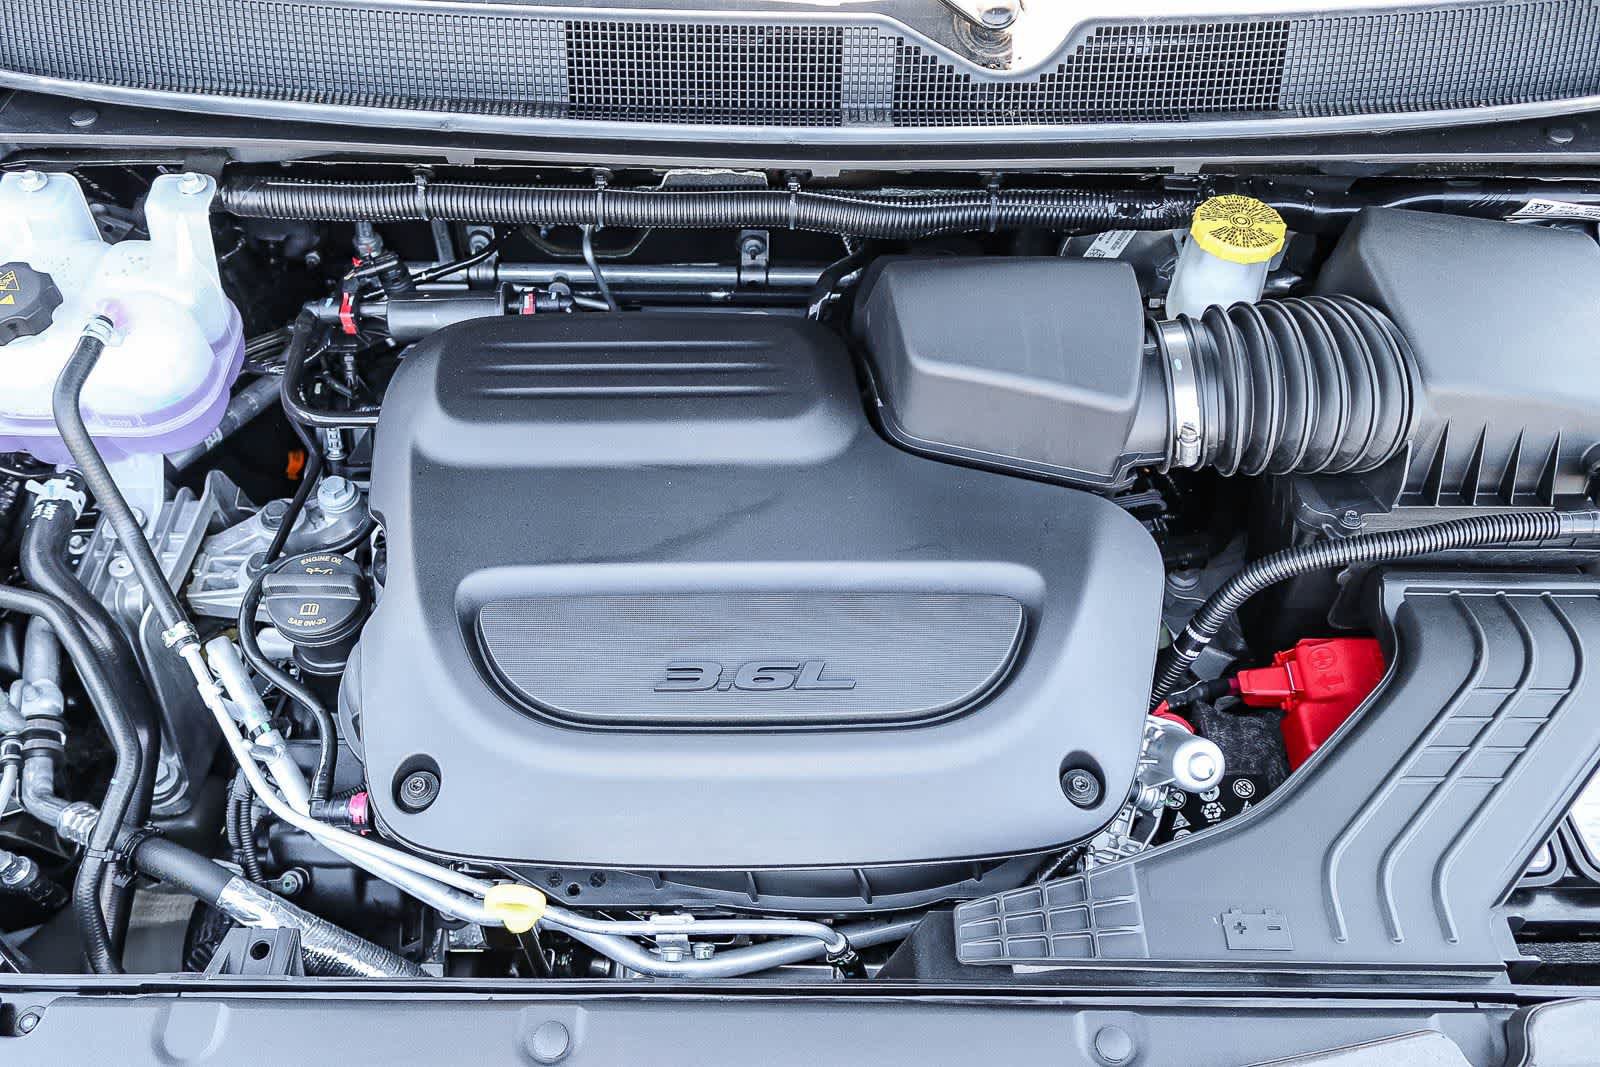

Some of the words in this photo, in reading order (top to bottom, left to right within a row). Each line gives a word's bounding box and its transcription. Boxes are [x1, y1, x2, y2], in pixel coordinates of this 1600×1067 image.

[301, 555, 330, 565] ENGINE
[331, 556, 343, 565] OIL
[288, 617, 302, 626] SAE
[303, 617, 327, 627] 0W-20
[654, 660, 857, 692] 3.6L
